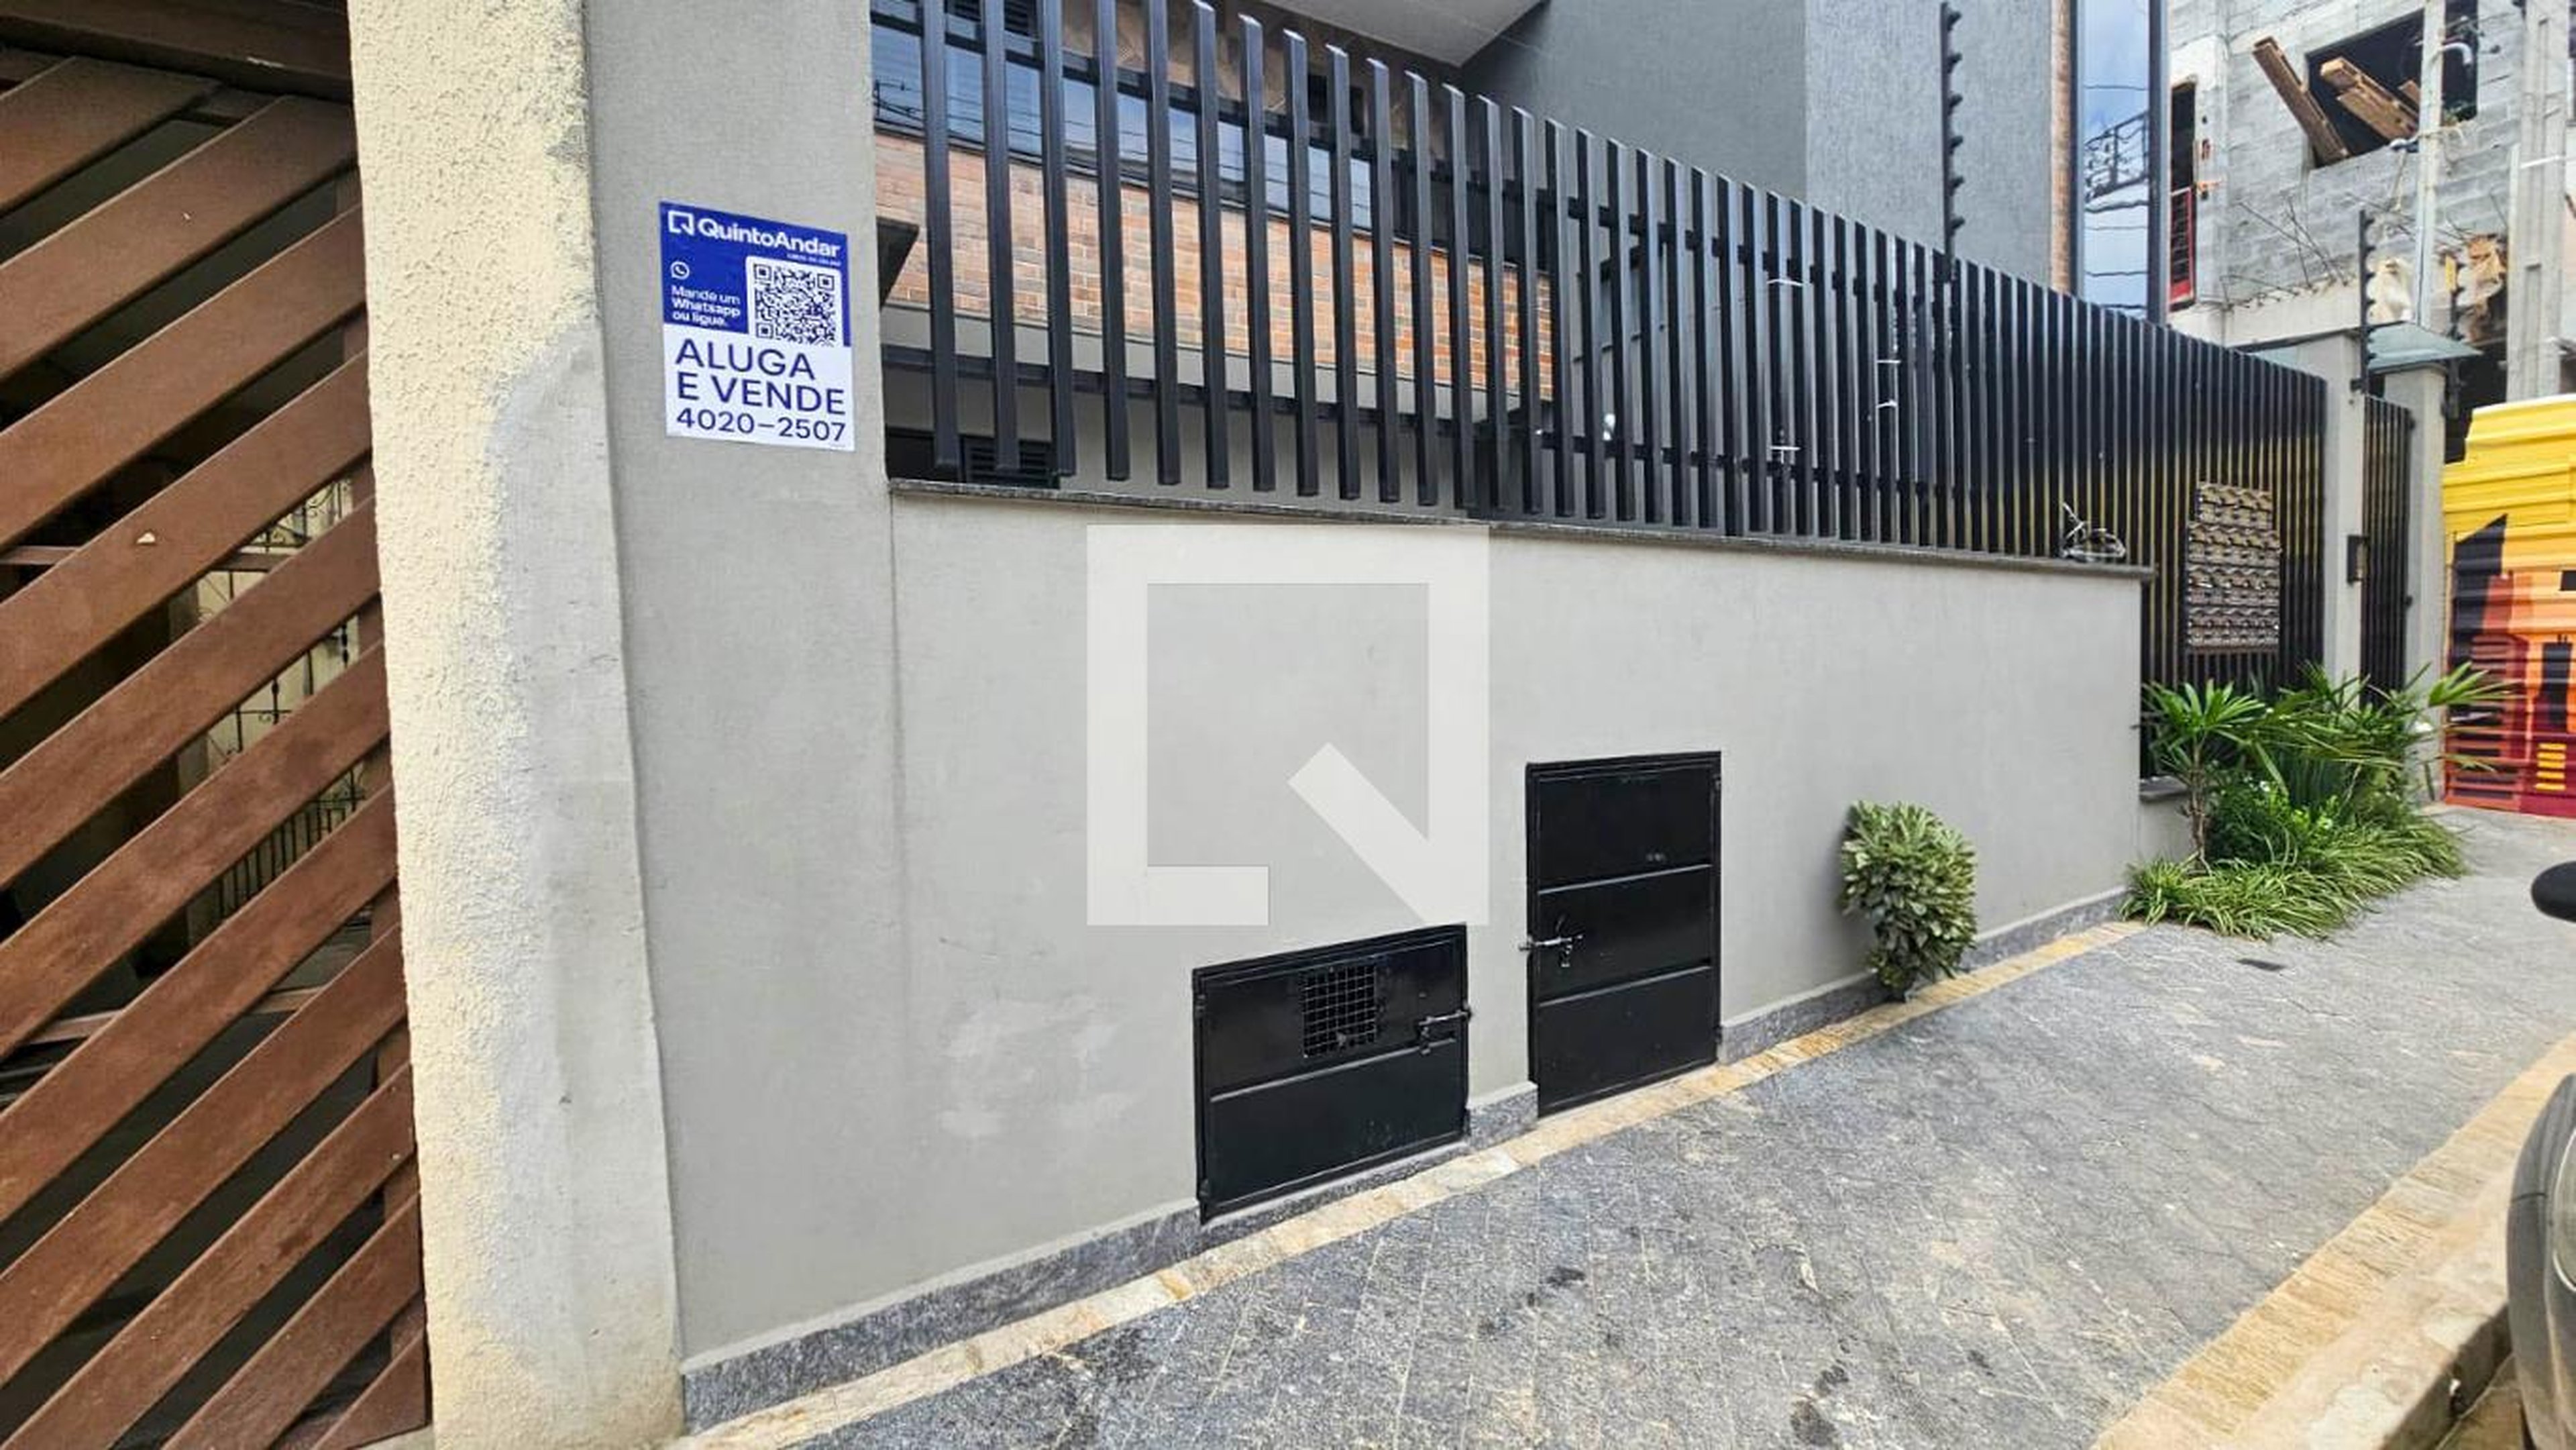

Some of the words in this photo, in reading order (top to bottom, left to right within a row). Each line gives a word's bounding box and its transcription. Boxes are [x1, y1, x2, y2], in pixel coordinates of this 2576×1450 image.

[698, 217, 841, 258] QuintoAndar
[672, 284, 717, 301] Mande
[719, 294, 740, 305] um
[672, 297, 741, 318] Whatsapp
[673, 311, 690, 321] ou
[675, 338, 816, 380] ALUGA
[678, 371, 699, 401] E
[711, 374, 846, 415] VENDE
[676, 407, 846, 442] 4020-2507
